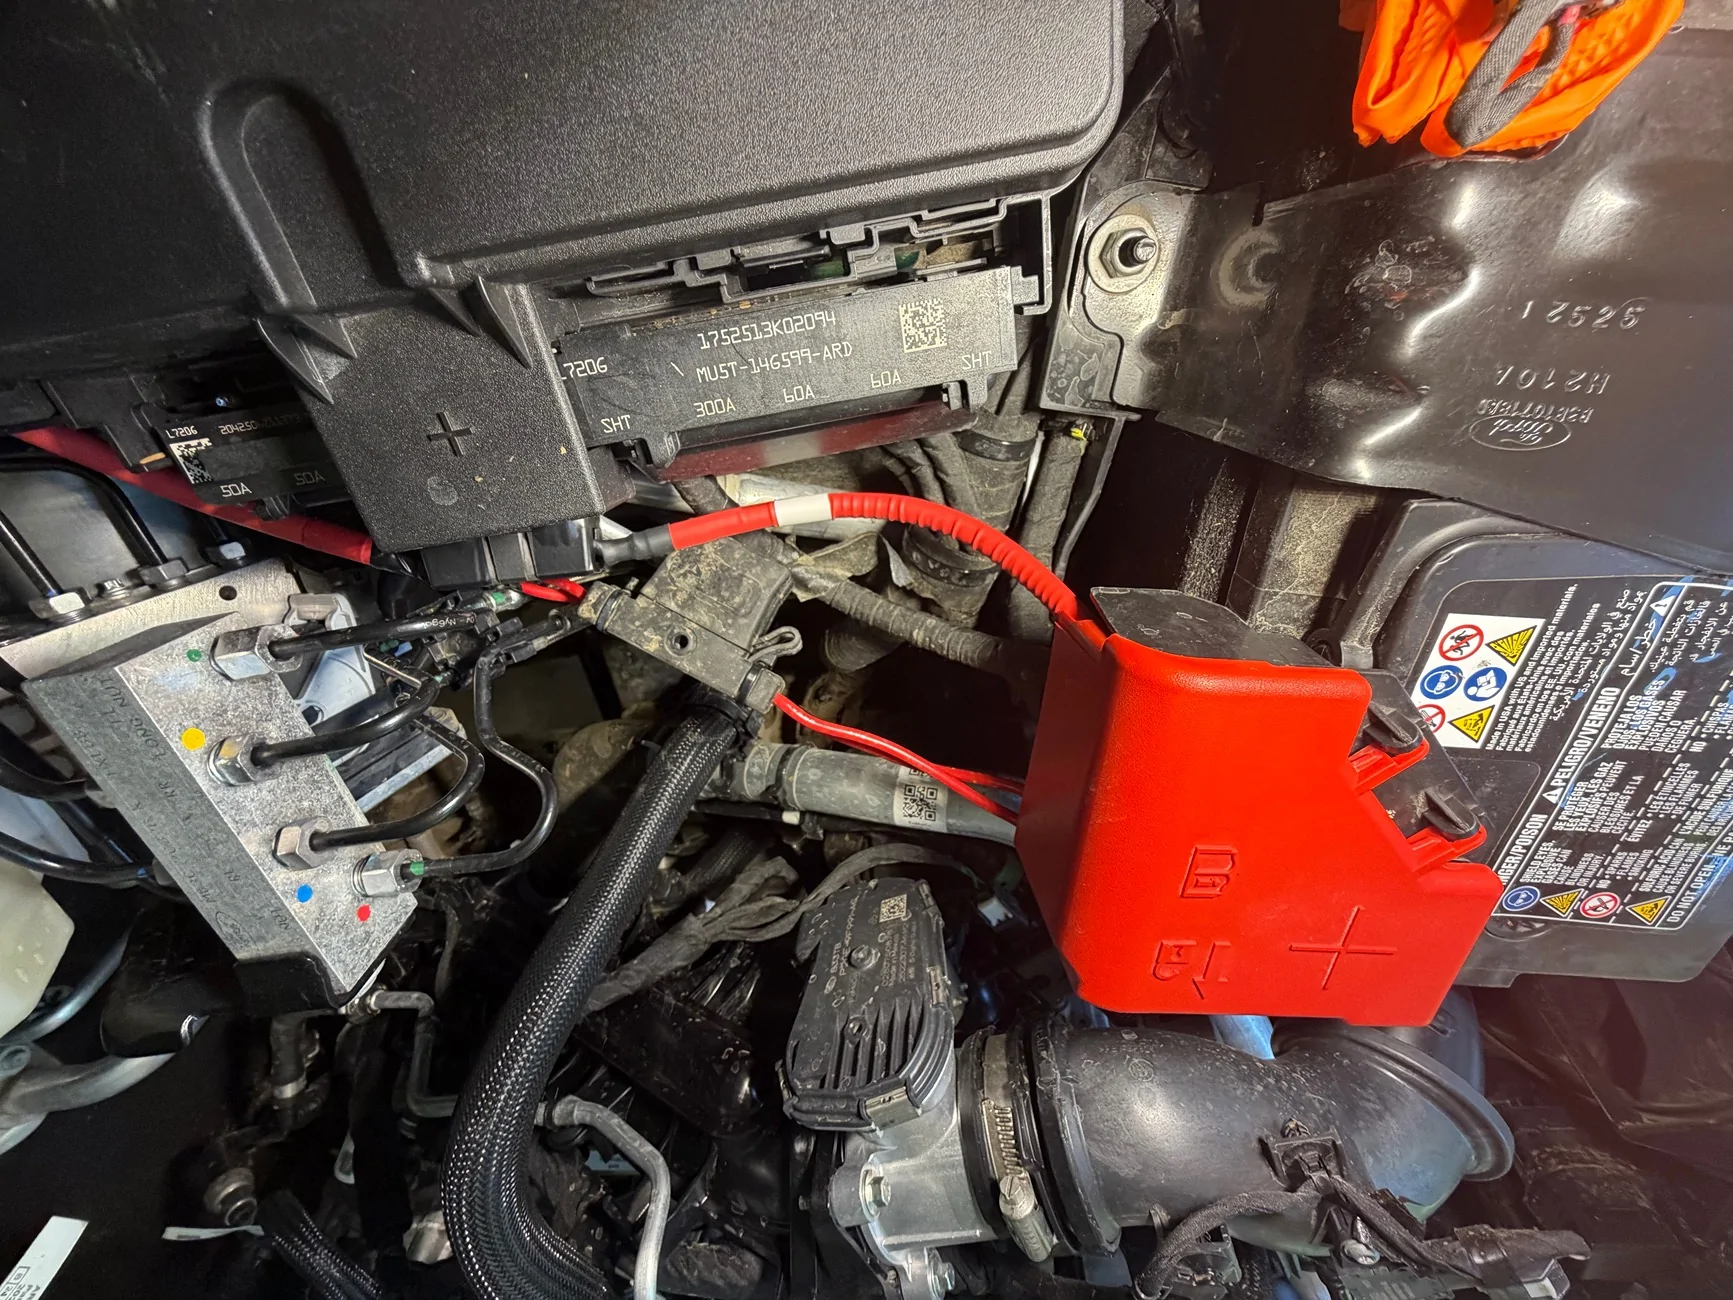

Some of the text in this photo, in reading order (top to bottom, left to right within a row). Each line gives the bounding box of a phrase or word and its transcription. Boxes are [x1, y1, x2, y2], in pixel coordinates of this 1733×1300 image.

[699, 310, 837, 350] 1752513K02094
[961, 350, 993, 371] SHT
[693, 370, 902, 419] 300A 60A 60A
[600, 413, 632, 433] SHT
[1488, 417, 1554, 446] Ford
[219, 482, 252, 498] 50A
[294, 470, 326, 486] 50A
[1605, 611, 1621, 619] في
[1614, 589, 1635, 608] صنع
[1485, 583, 1578, 749] Made in USA with US and imported materials.
[1514, 602, 1600, 751] Fabricardo en los EE. UU. con materiales
[1495, 630, 1564, 750] Fabriqué aux États-Unis avec des
[1504, 629, 1575, 751] matériaux américains et importés.
[1524, 691, 1560, 752] estadounidenses
[1556, 639, 1590, 684] importados.
[1600, 694, 1643, 748] PROTEJA LOS
[1612, 679, 1665, 749] OJOS. LOS GASES
[1625, 699, 1666, 749] EXPLOSIVOS
[1637, 689, 1687, 750] PUEDEN CAUSAR
[1688, 701, 1729, 752] NO CHISPAS
[1650, 727, 1677, 751] DAÑOS
[1663, 716, 1698, 753] CEGUERA.
[1497, 813, 1548, 885] NGER/POISON
[1549, 686, 1622, 786] PELIGRO/VENENO
[1563, 761, 1614, 831] LES YEUX. LES GAZ
[1574, 759, 1628, 831] EXPLOSIFS PEUVENT
[1598, 775, 1645, 833] BLESSURES ET LA
[1624, 762, 1691, 842] ÉVITEZ LES ÉTINCELLES
[1658, 769, 1700, 813] LES FLAMMES
[1670, 782, 1703, 814] DE FUMER
[1551, 821, 1567, 830] SE
[1587, 791, 1620, 832] CAUSER DES
[1677, 810, 1706, 834] L'ACIDE
[1519, 839, 1556, 882] SHIELD EYES.
[1530, 847, 1562, 882] EXPLOSIVE
[1541, 849, 1572, 883] GASES CAN
[1553, 865, 1574, 884] CAUSE
[1564, 852, 1594, 885] BLINDNESS
[1576, 853, 1606, 886] OR INJURY.
[1594, 851, 1628, 888] NO SPARKS
[1615, 851, 1640, 875] FLAMES
[1637, 837, 1686, 891] SULFURIC ACID CAN
[1669, 862, 1693, 884] SEVERE
[1651, 874, 1673, 892] CAUSE
[1663, 884, 1678, 893] OR
[1665, 910, 1685, 922] DO
[1675, 890, 1699, 907] NOT
[1711, 843, 1731, 856] NE
